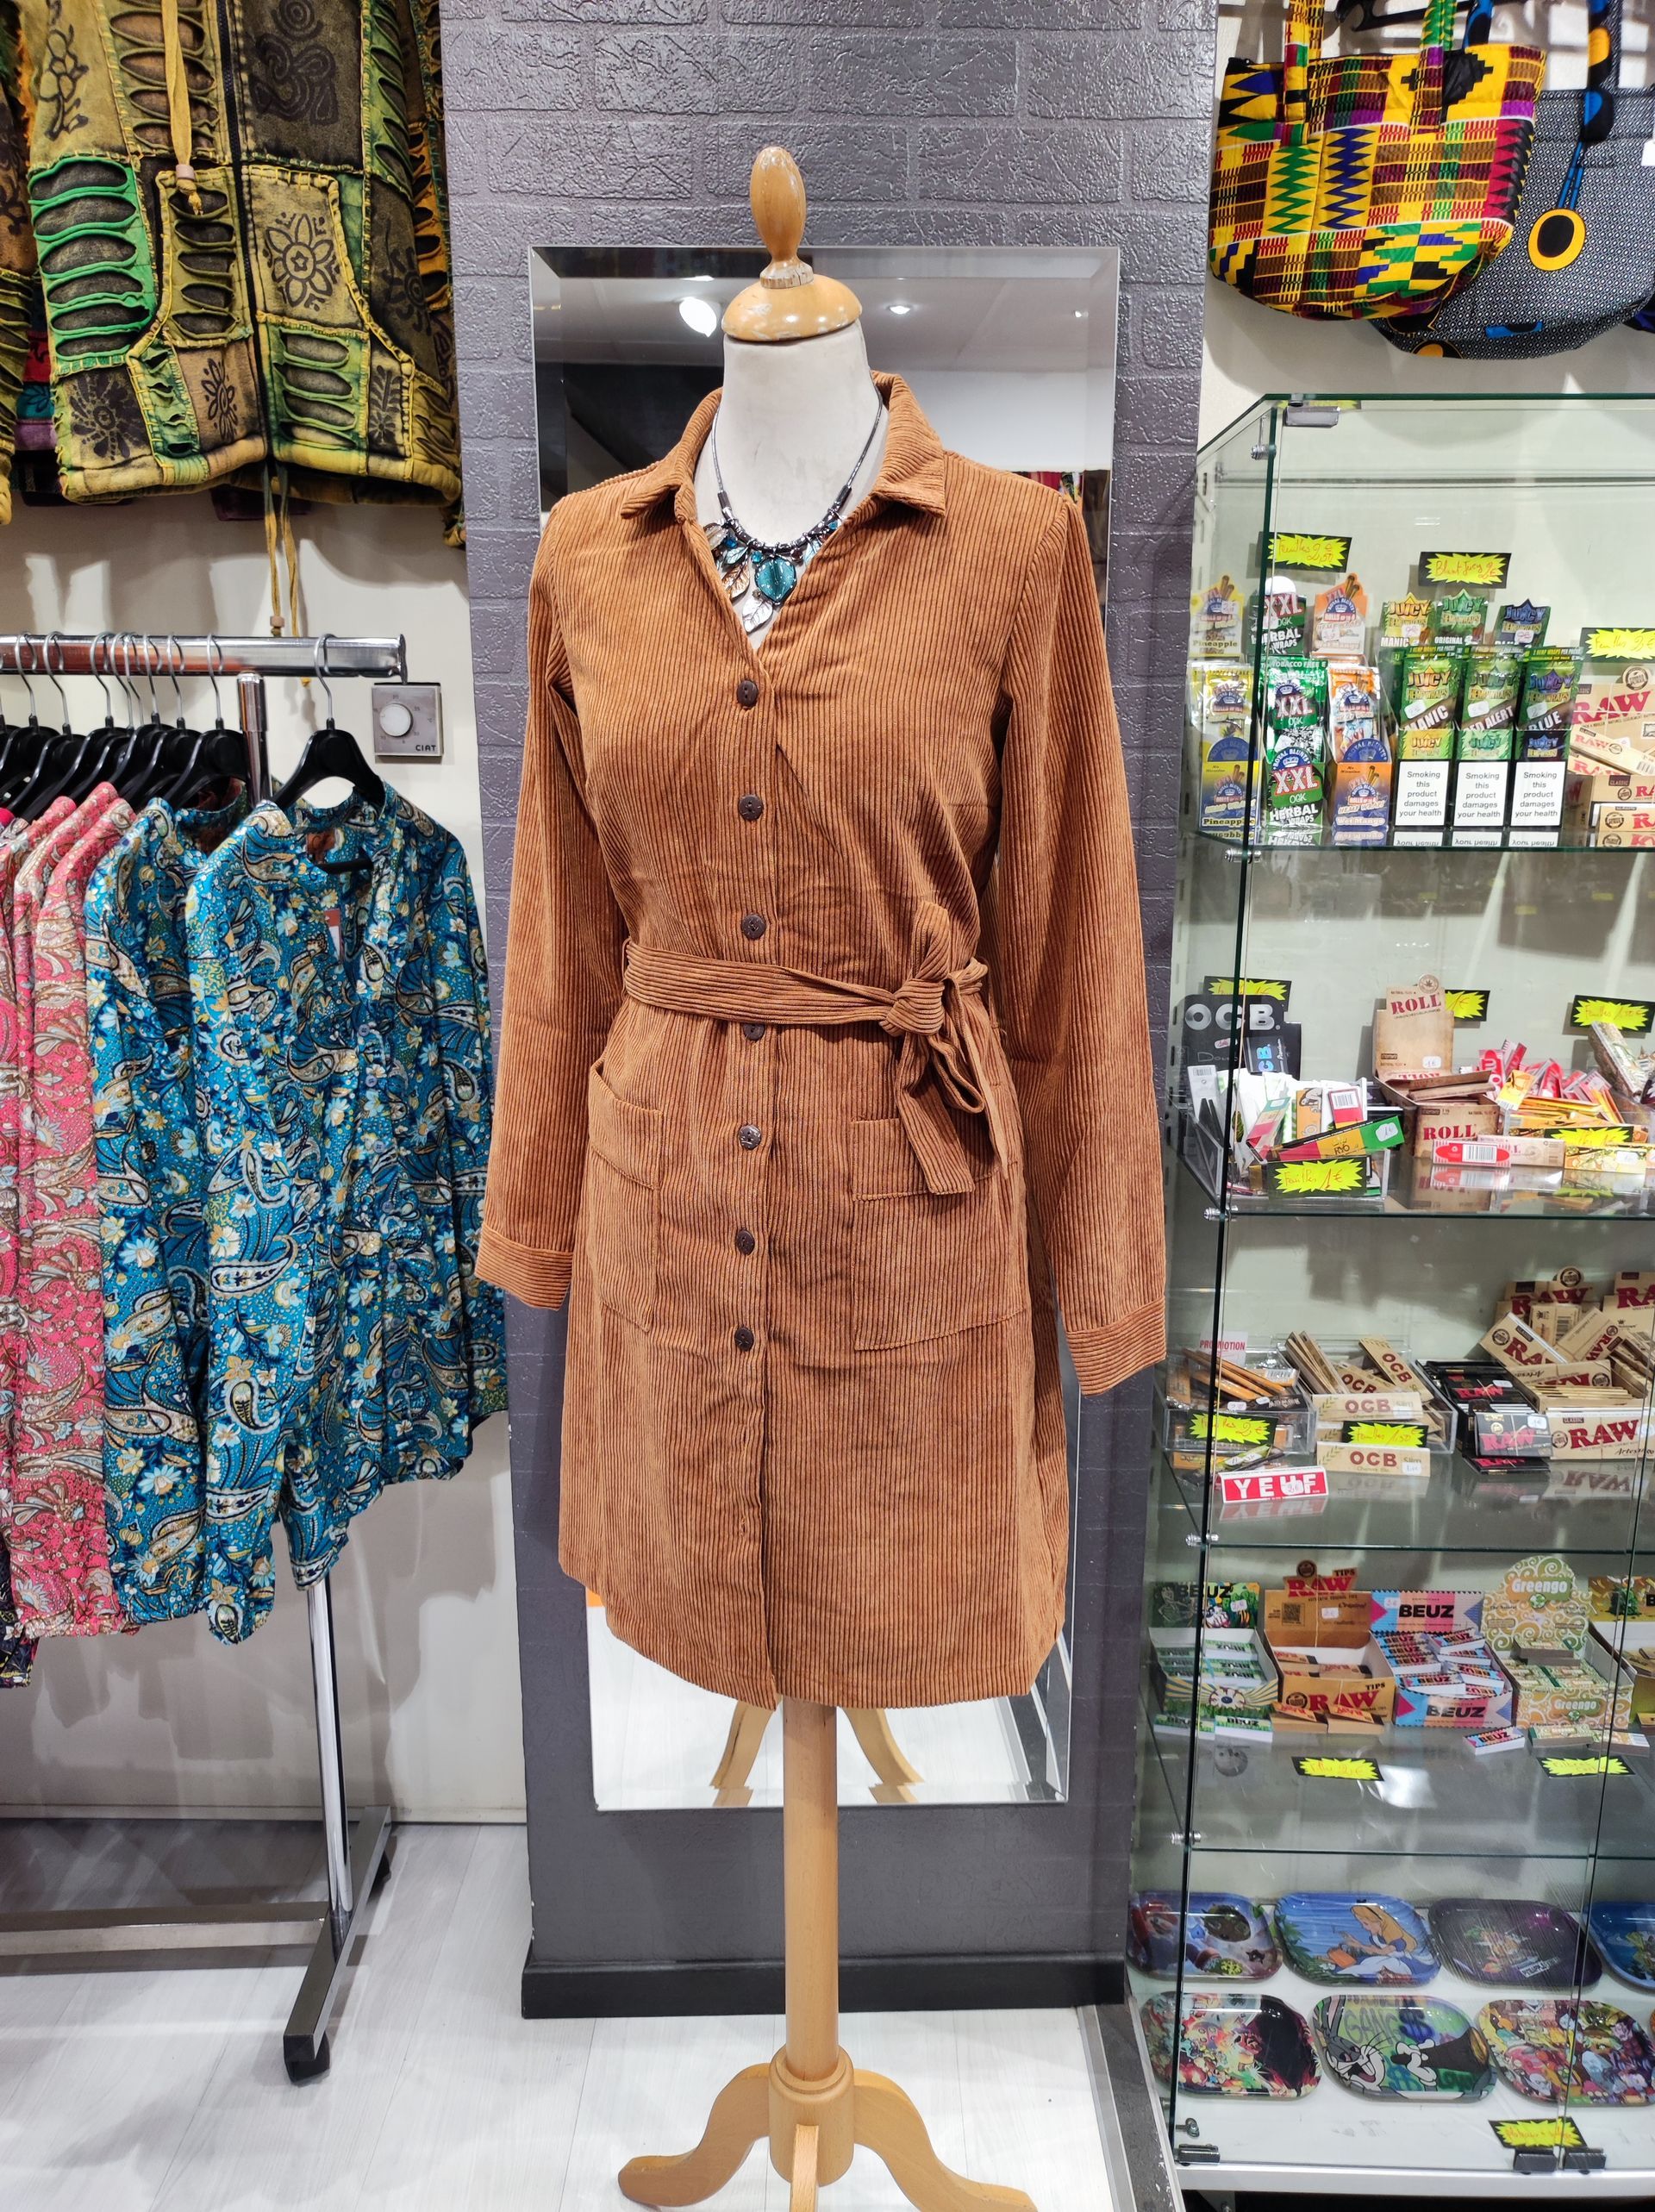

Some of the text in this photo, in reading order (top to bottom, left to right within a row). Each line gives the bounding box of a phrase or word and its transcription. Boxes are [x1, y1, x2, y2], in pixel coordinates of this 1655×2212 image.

[1389, 600, 1431, 616] JUICY
[1441, 596, 1484, 614] JUICY
[1504, 605, 1546, 622] JUICY
[1380, 636, 1409, 647] MANIC
[1434, 636, 1464, 646] ORIGINAL
[1407, 672, 1451, 687] JUICY
[1470, 672, 1514, 688] JUICY
[1528, 672, 1574, 690] JUICY
[1407, 689, 1449, 701] HEMP WRAPS
[1468, 689, 1514, 700] HEMP WRAPS
[1546, 690, 1569, 703] WRAPS
[1276, 694, 1315, 718] XXL
[1572, 690, 1651, 725] RAW
[1405, 705, 1449, 730] MANIC
[1485, 706, 1514, 729] ALERT
[1528, 710, 1563, 730] BLUE
[1410, 736, 1441, 748] JUICY
[1469, 736, 1502, 749] JUICY
[1527, 737, 1559, 748] JUICY
[1575, 734, 1609, 749] RAW
[1273, 748, 1308, 767] ROYAL BLUNTS
[1273, 766, 1319, 795] XXL
[1407, 771, 1440, 779] Smoking
[1465, 772, 1500, 781] Smoking
[1523, 772, 1558, 780] Smoking
[1465, 791, 1496, 800] product
[1523, 790, 1554, 799] product
[1270, 803, 1319, 821] HERBAL
[1403, 800, 1439, 809] damages
[1462, 801, 1498, 809] damages
[1390, 994, 1442, 1015] ROLL
[1422, 1124, 1477, 1140] ROLL
[1585, 1334, 1613, 1361] RAW
[1382, 1353, 1413, 1383] OCB
[1341, 1373, 1377, 1393] OCB
[1455, 1386, 1503, 1400] RAW
[1345, 1398, 1391, 1414] OCB
[1479, 1428, 1536, 1452] RAW
[1568, 1419, 1639, 1449] RAW
[1350, 1451, 1397, 1467] OCB
[1333, 1568, 1356, 1577] TIPS
[1287, 1576, 1353, 1598] RAW
[1511, 1579, 1568, 1595] Greengo
[1398, 1604, 1455, 1619] BEUZ
[1444, 1633, 1474, 1644] BEUZ
[1365, 1682, 1386, 1690] TIPS
[1418, 1676, 1452, 1684] BEUZ
[1308, 1690, 1380, 1711] RAW
[1554, 1699, 1597, 1710] Greengo
[1426, 1705, 1486, 1718] BEUZ
[1227, 1717, 1260, 1727] BEUZ
[1479, 1731, 1510, 1743] BEUZ
